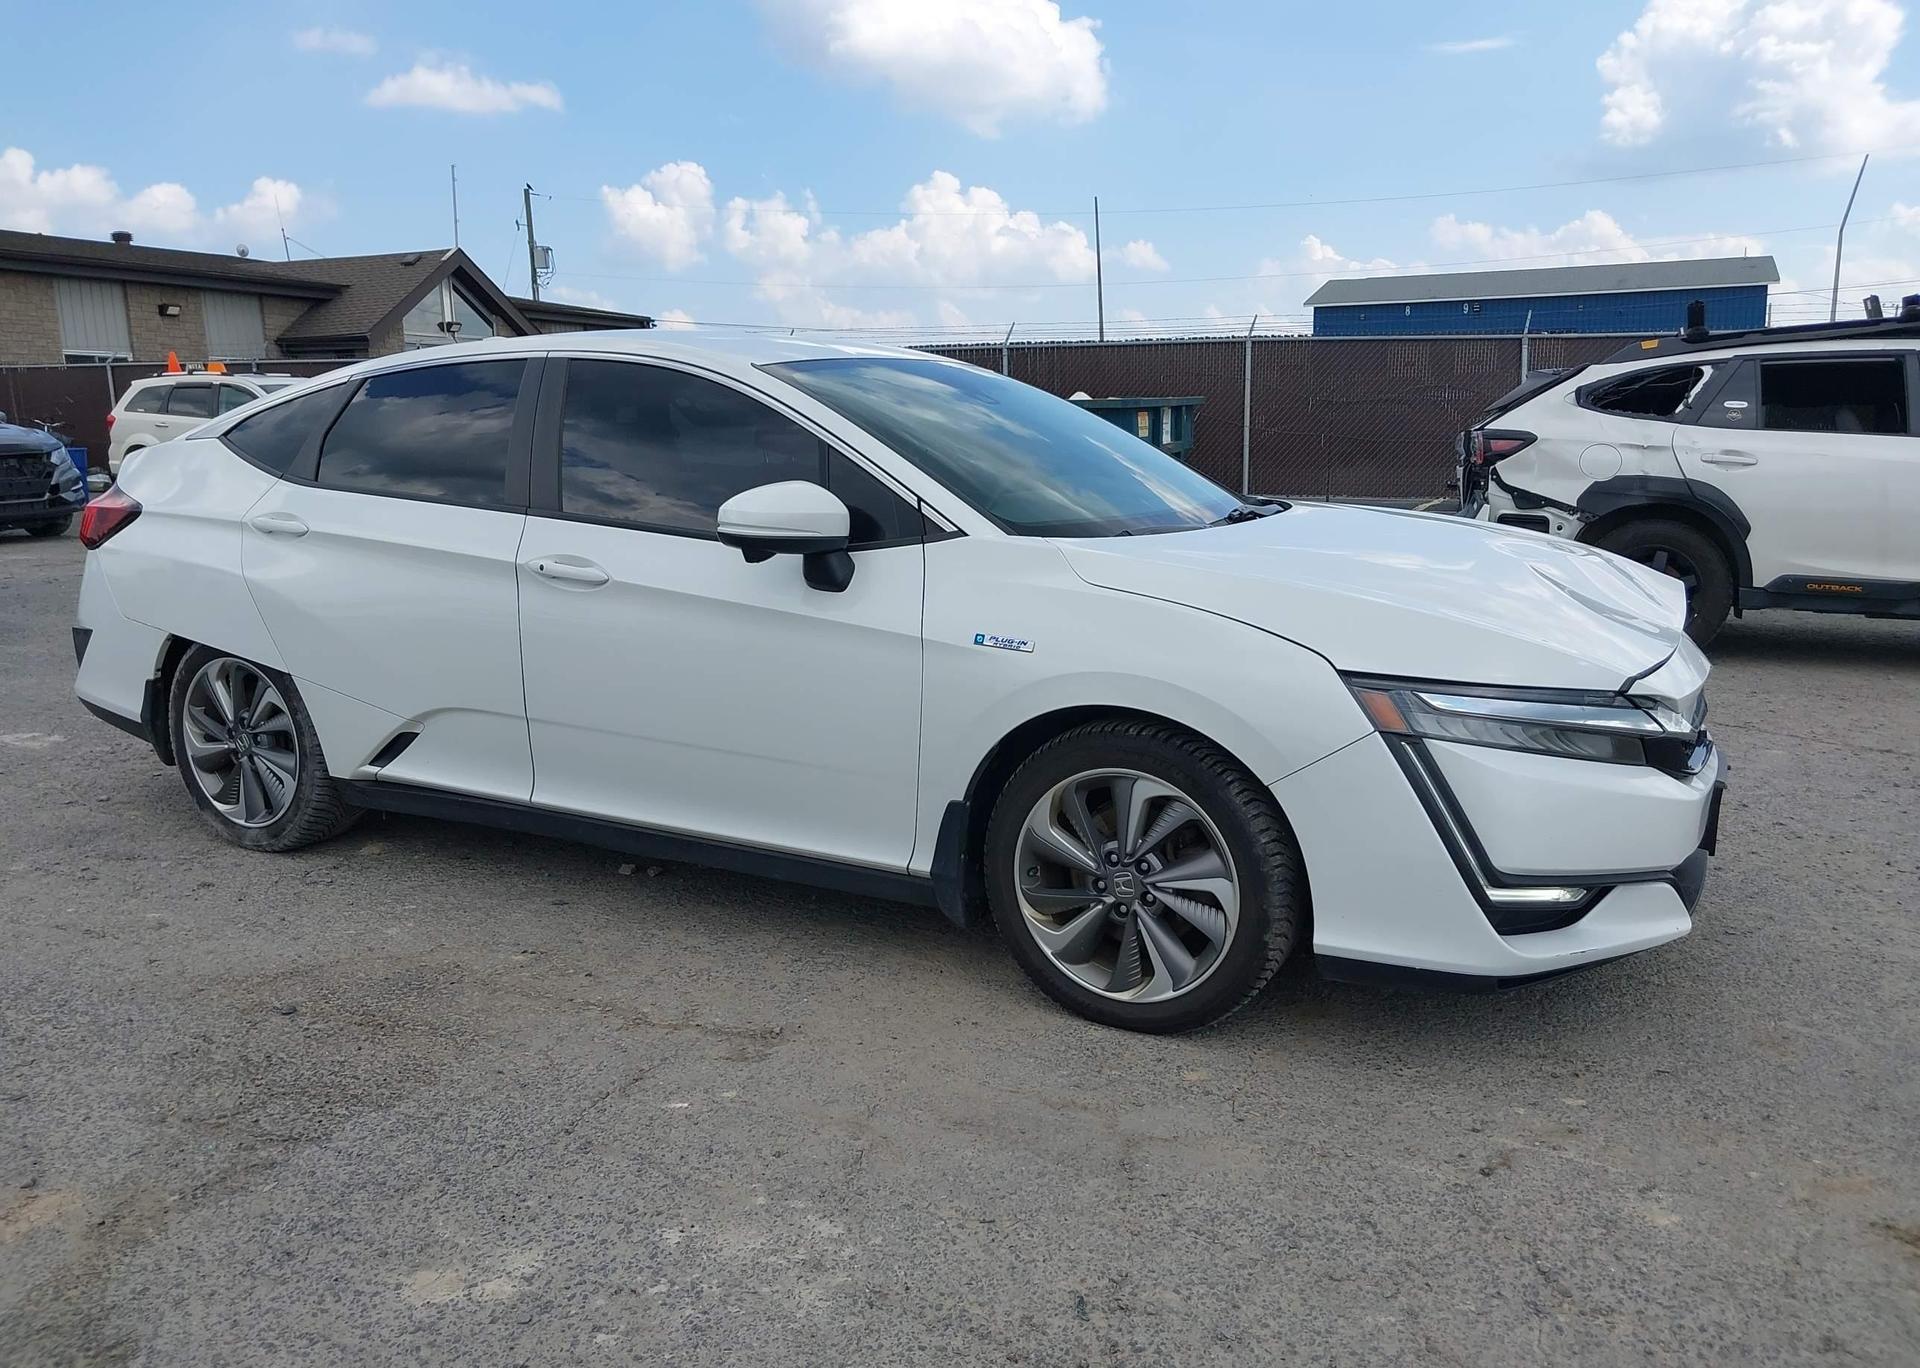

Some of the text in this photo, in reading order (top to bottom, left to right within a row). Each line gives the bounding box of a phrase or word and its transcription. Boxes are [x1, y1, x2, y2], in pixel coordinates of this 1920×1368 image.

[1405, 305, 1411, 316] 8
[1463, 303, 1469, 314] 9
[1806, 583, 1863, 592] OUTBACK
[988, 635, 1029, 646] PLUG-IN
